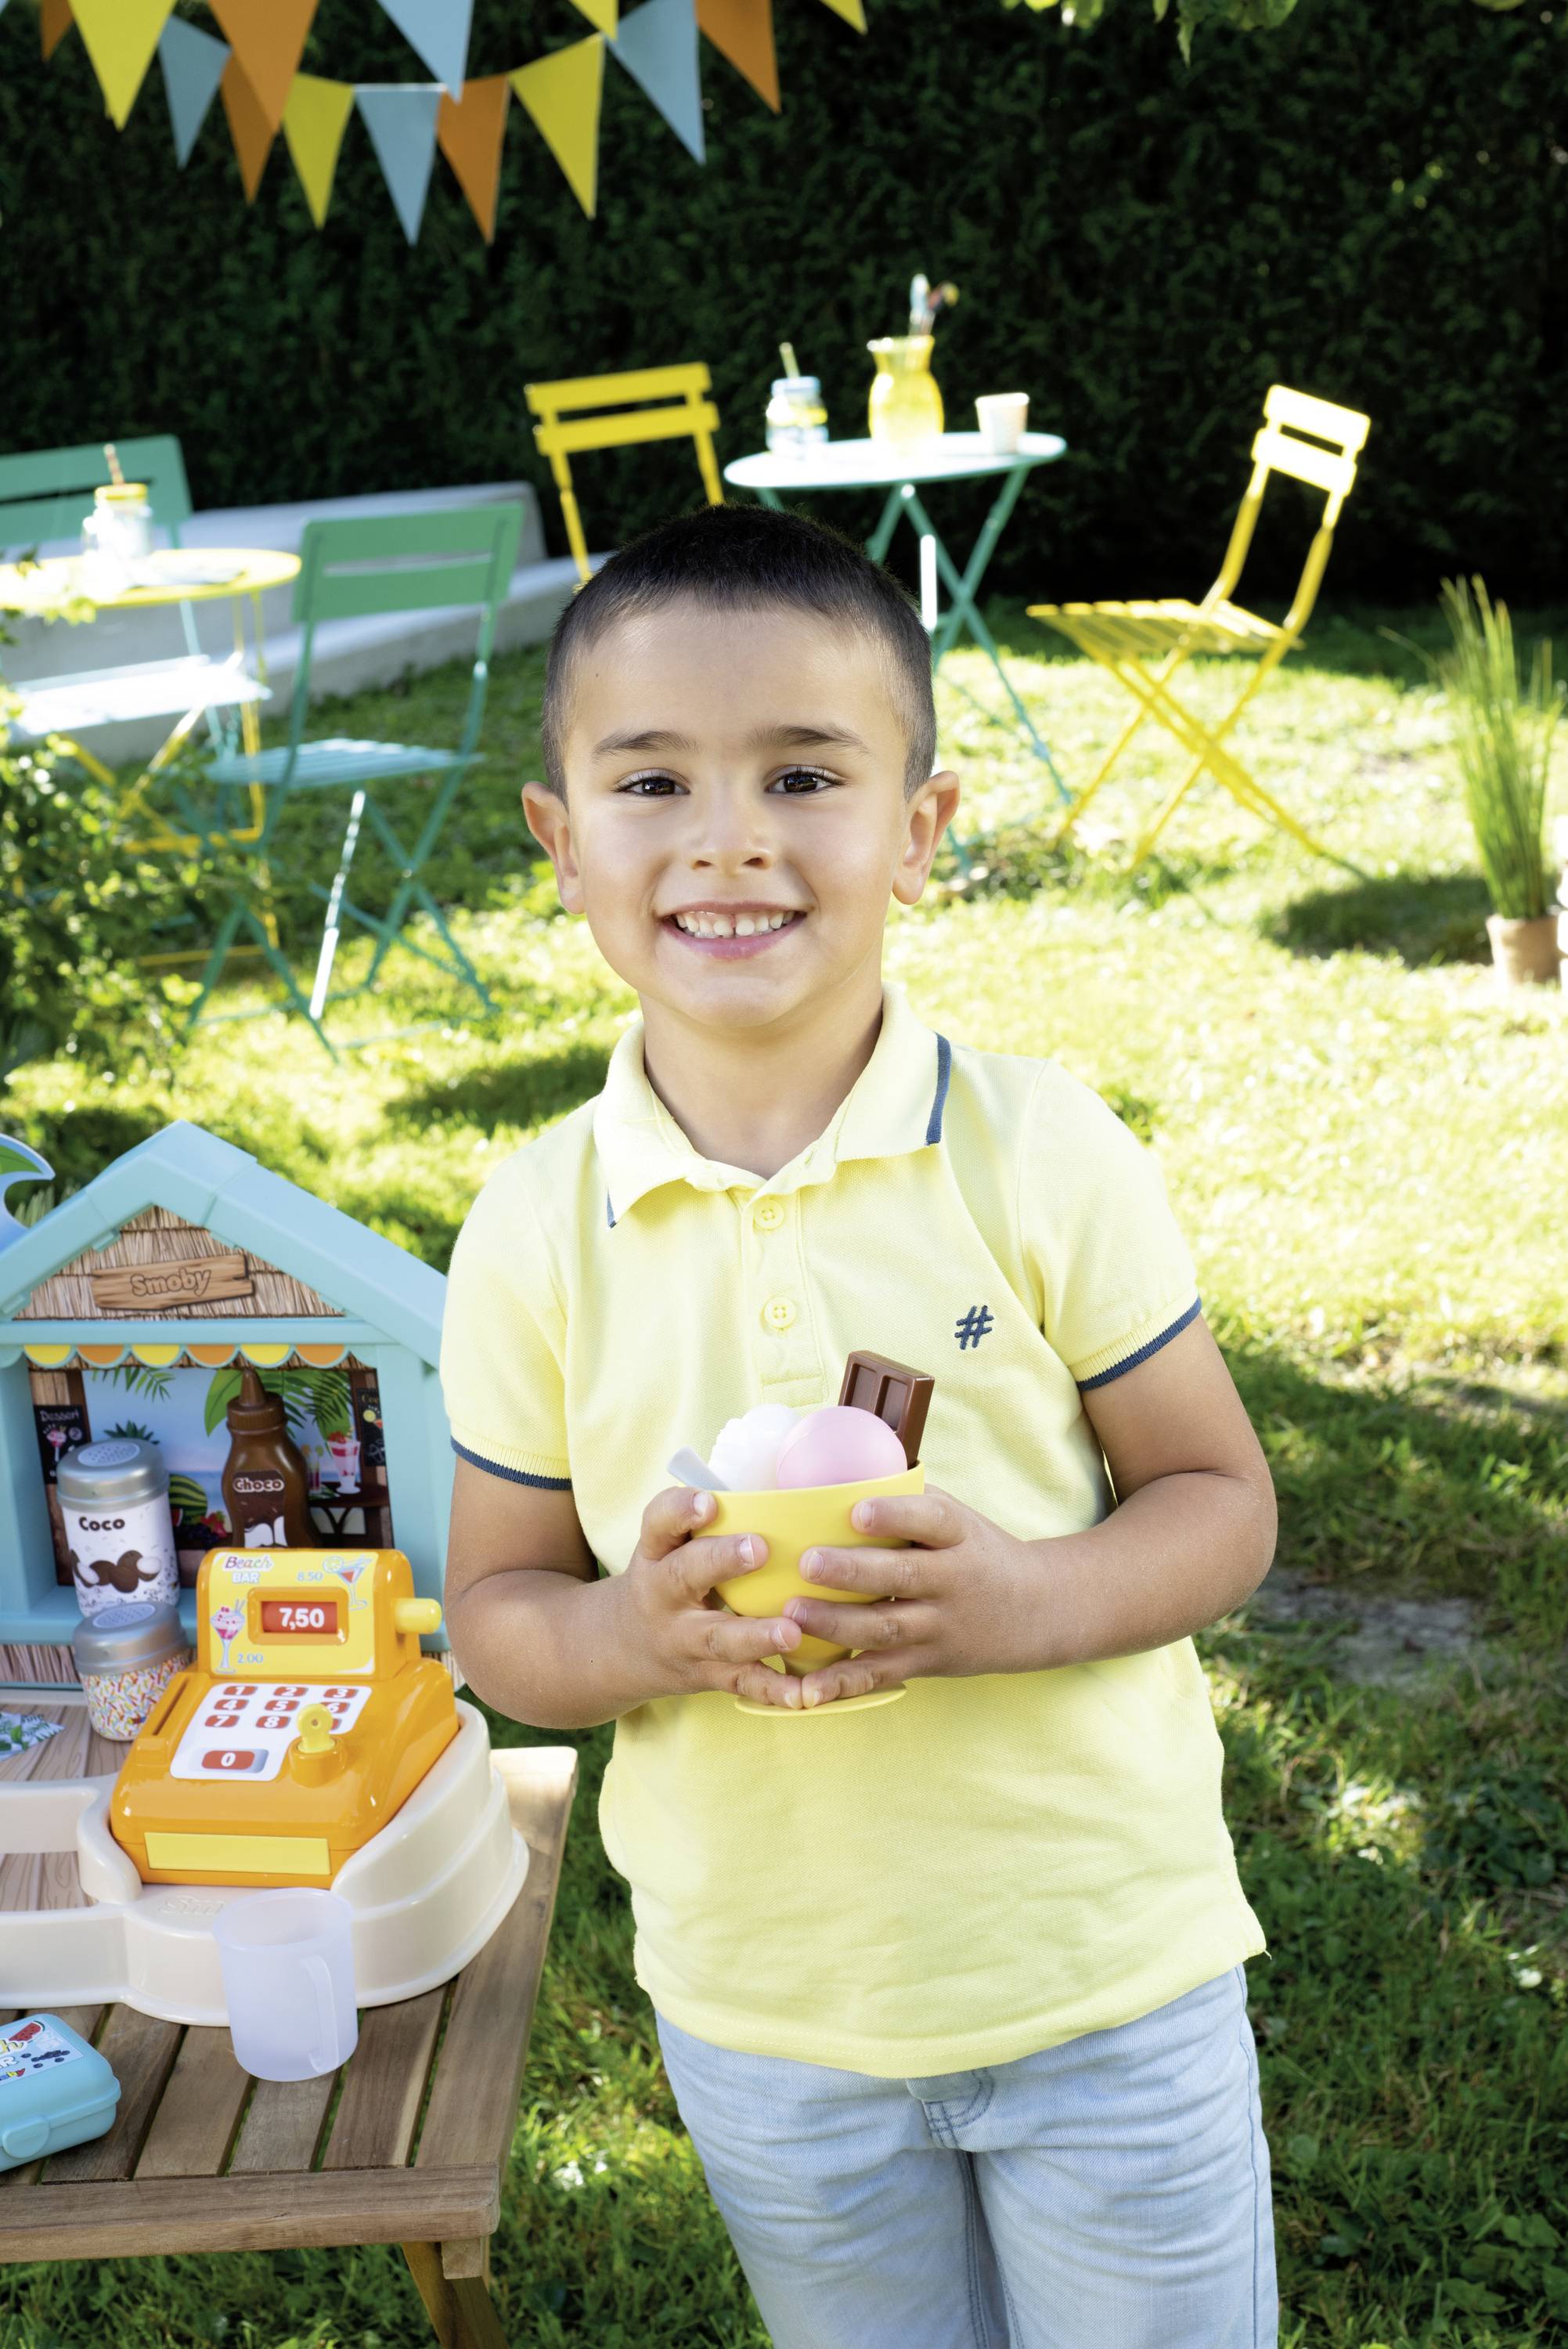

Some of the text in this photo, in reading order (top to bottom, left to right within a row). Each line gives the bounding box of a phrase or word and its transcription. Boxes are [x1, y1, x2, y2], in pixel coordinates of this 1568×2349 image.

[130, 1268, 212, 1297] Smoby
[232, 1478, 285, 1493] Choco
[78, 1516, 125, 1532] Coco
[225, 1555, 272, 1570] Beach
[232, 1571, 260, 1583] BAR
[297, 1571, 323, 1581] 8.50
[279, 1607, 325, 1630] 7,50
[237, 1653, 264, 1663] 2.00
[235, 1686, 348, 1698] 1 2 3
[222, 1700, 340, 1713] 4 5 6
[214, 1716, 279, 1729] 7 8
[221, 1752, 236, 1767] 0
